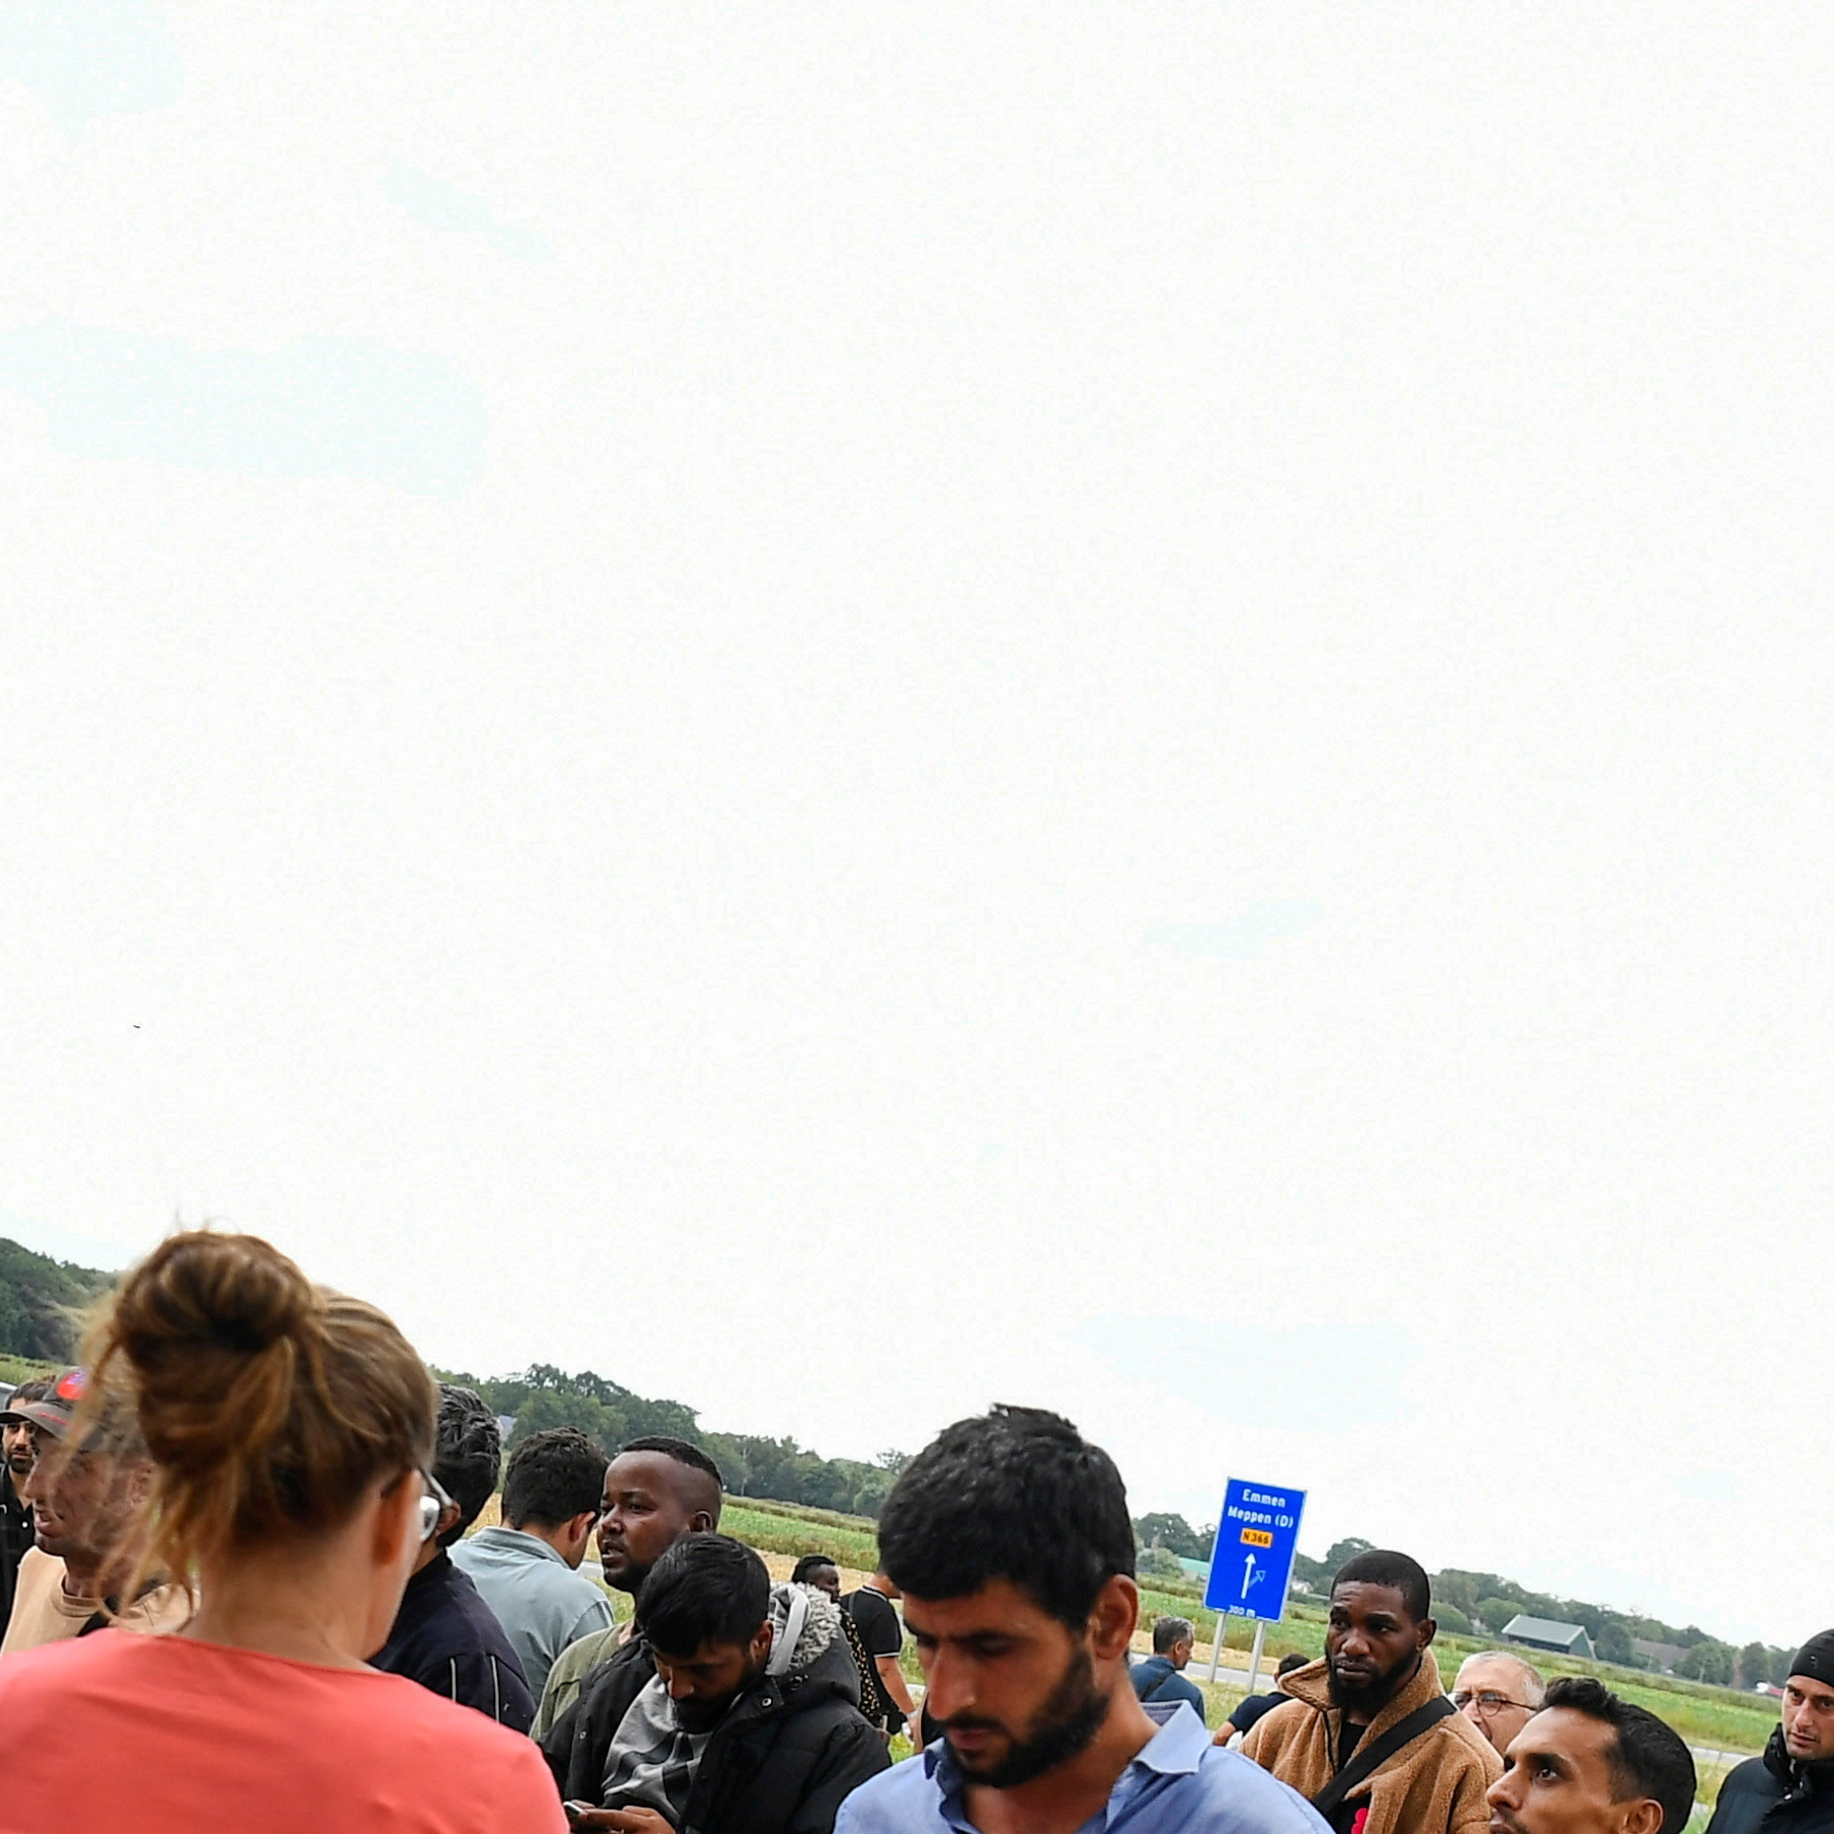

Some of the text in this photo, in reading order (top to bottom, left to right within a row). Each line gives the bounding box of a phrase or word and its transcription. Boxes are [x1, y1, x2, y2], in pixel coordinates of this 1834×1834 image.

[1242, 1488, 1286, 1508] Emmen
[1227, 1505, 1294, 1529] Meppen (D)
